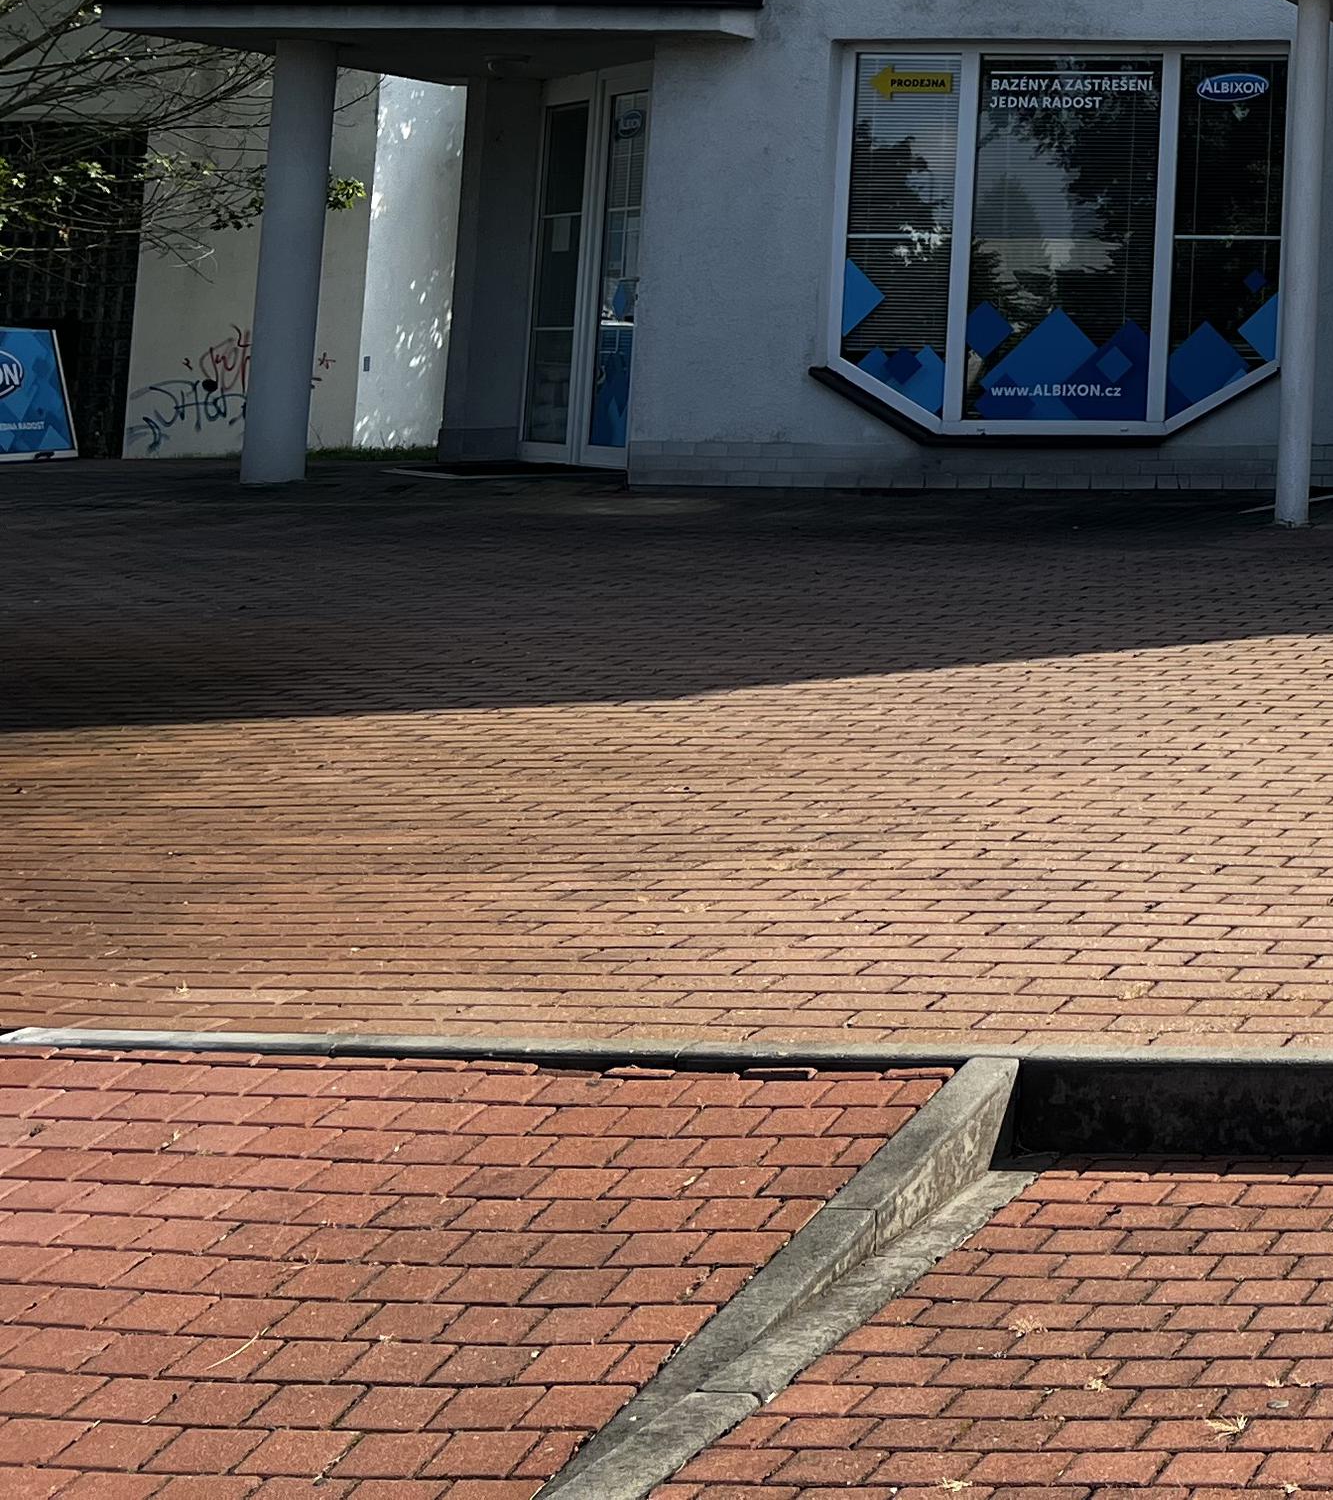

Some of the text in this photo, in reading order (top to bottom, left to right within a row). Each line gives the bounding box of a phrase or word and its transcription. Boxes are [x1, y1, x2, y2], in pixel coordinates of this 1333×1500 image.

[890, 78, 946, 89] PRODEJNA
[990, 76, 1153, 92] BAZÉNY A ZASTŘEŠENÍ
[1200, 77, 1265, 94] ALBIXON
[990, 96, 1102, 108] JEDNA RADOST
[990, 384, 1122, 397] www.ALBIXON.cz
